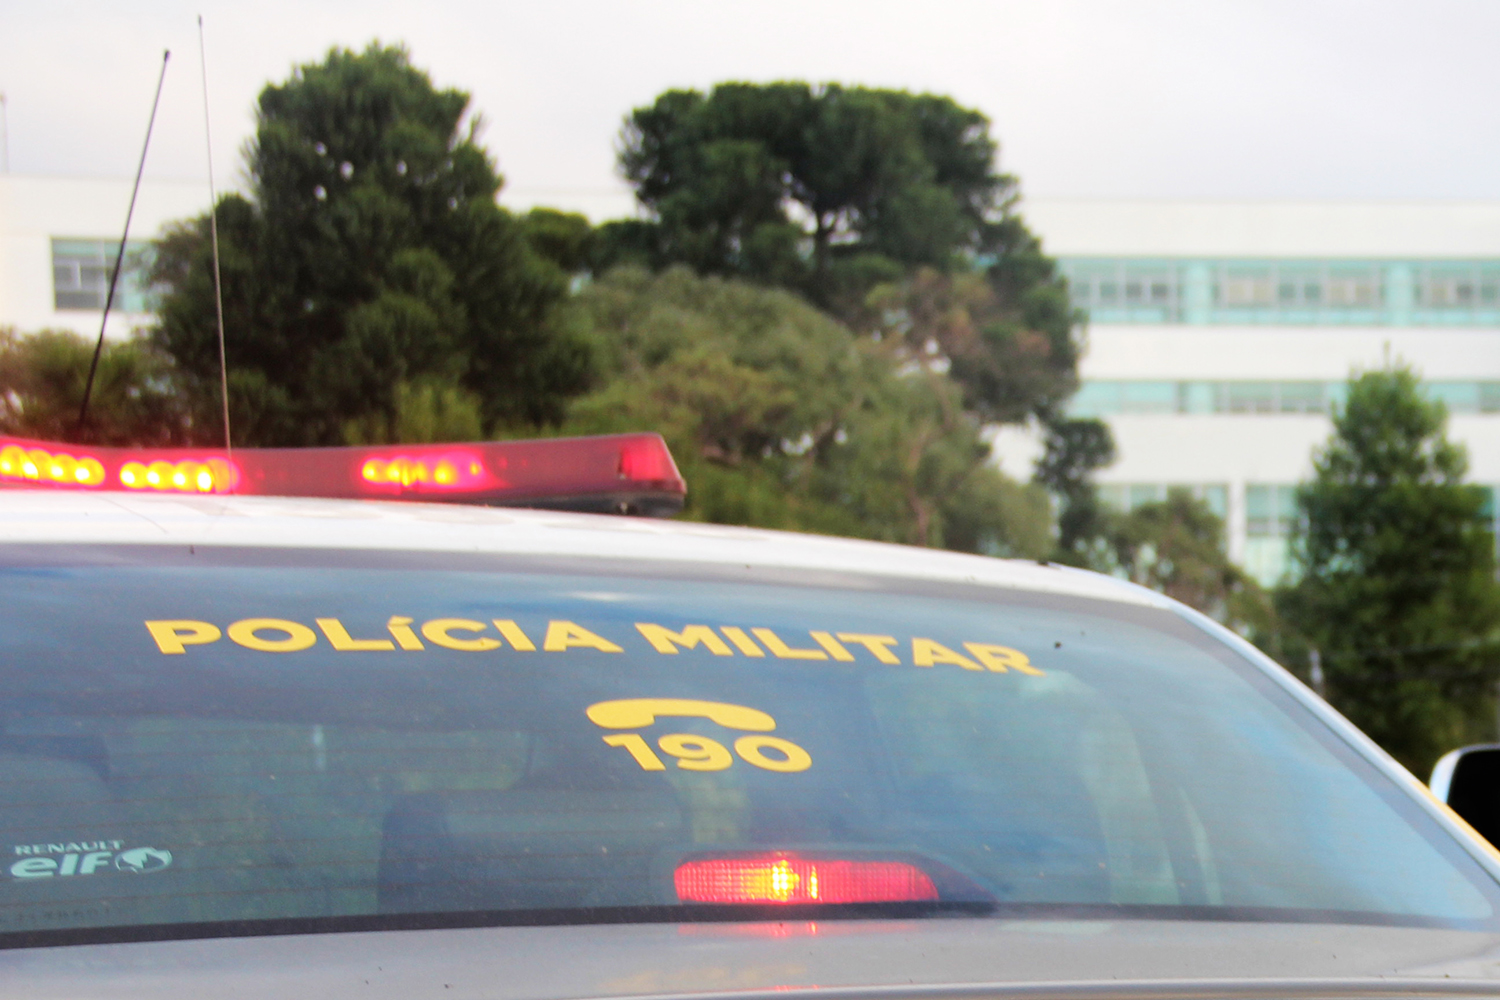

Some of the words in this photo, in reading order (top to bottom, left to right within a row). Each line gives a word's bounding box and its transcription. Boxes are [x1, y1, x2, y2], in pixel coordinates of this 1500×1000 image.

[145, 615, 624, 654] POLÍCIA
[635, 622, 1046, 676] MILITAR
[602, 733, 813, 772] 190
[15, 840, 124, 855] RENAULT
